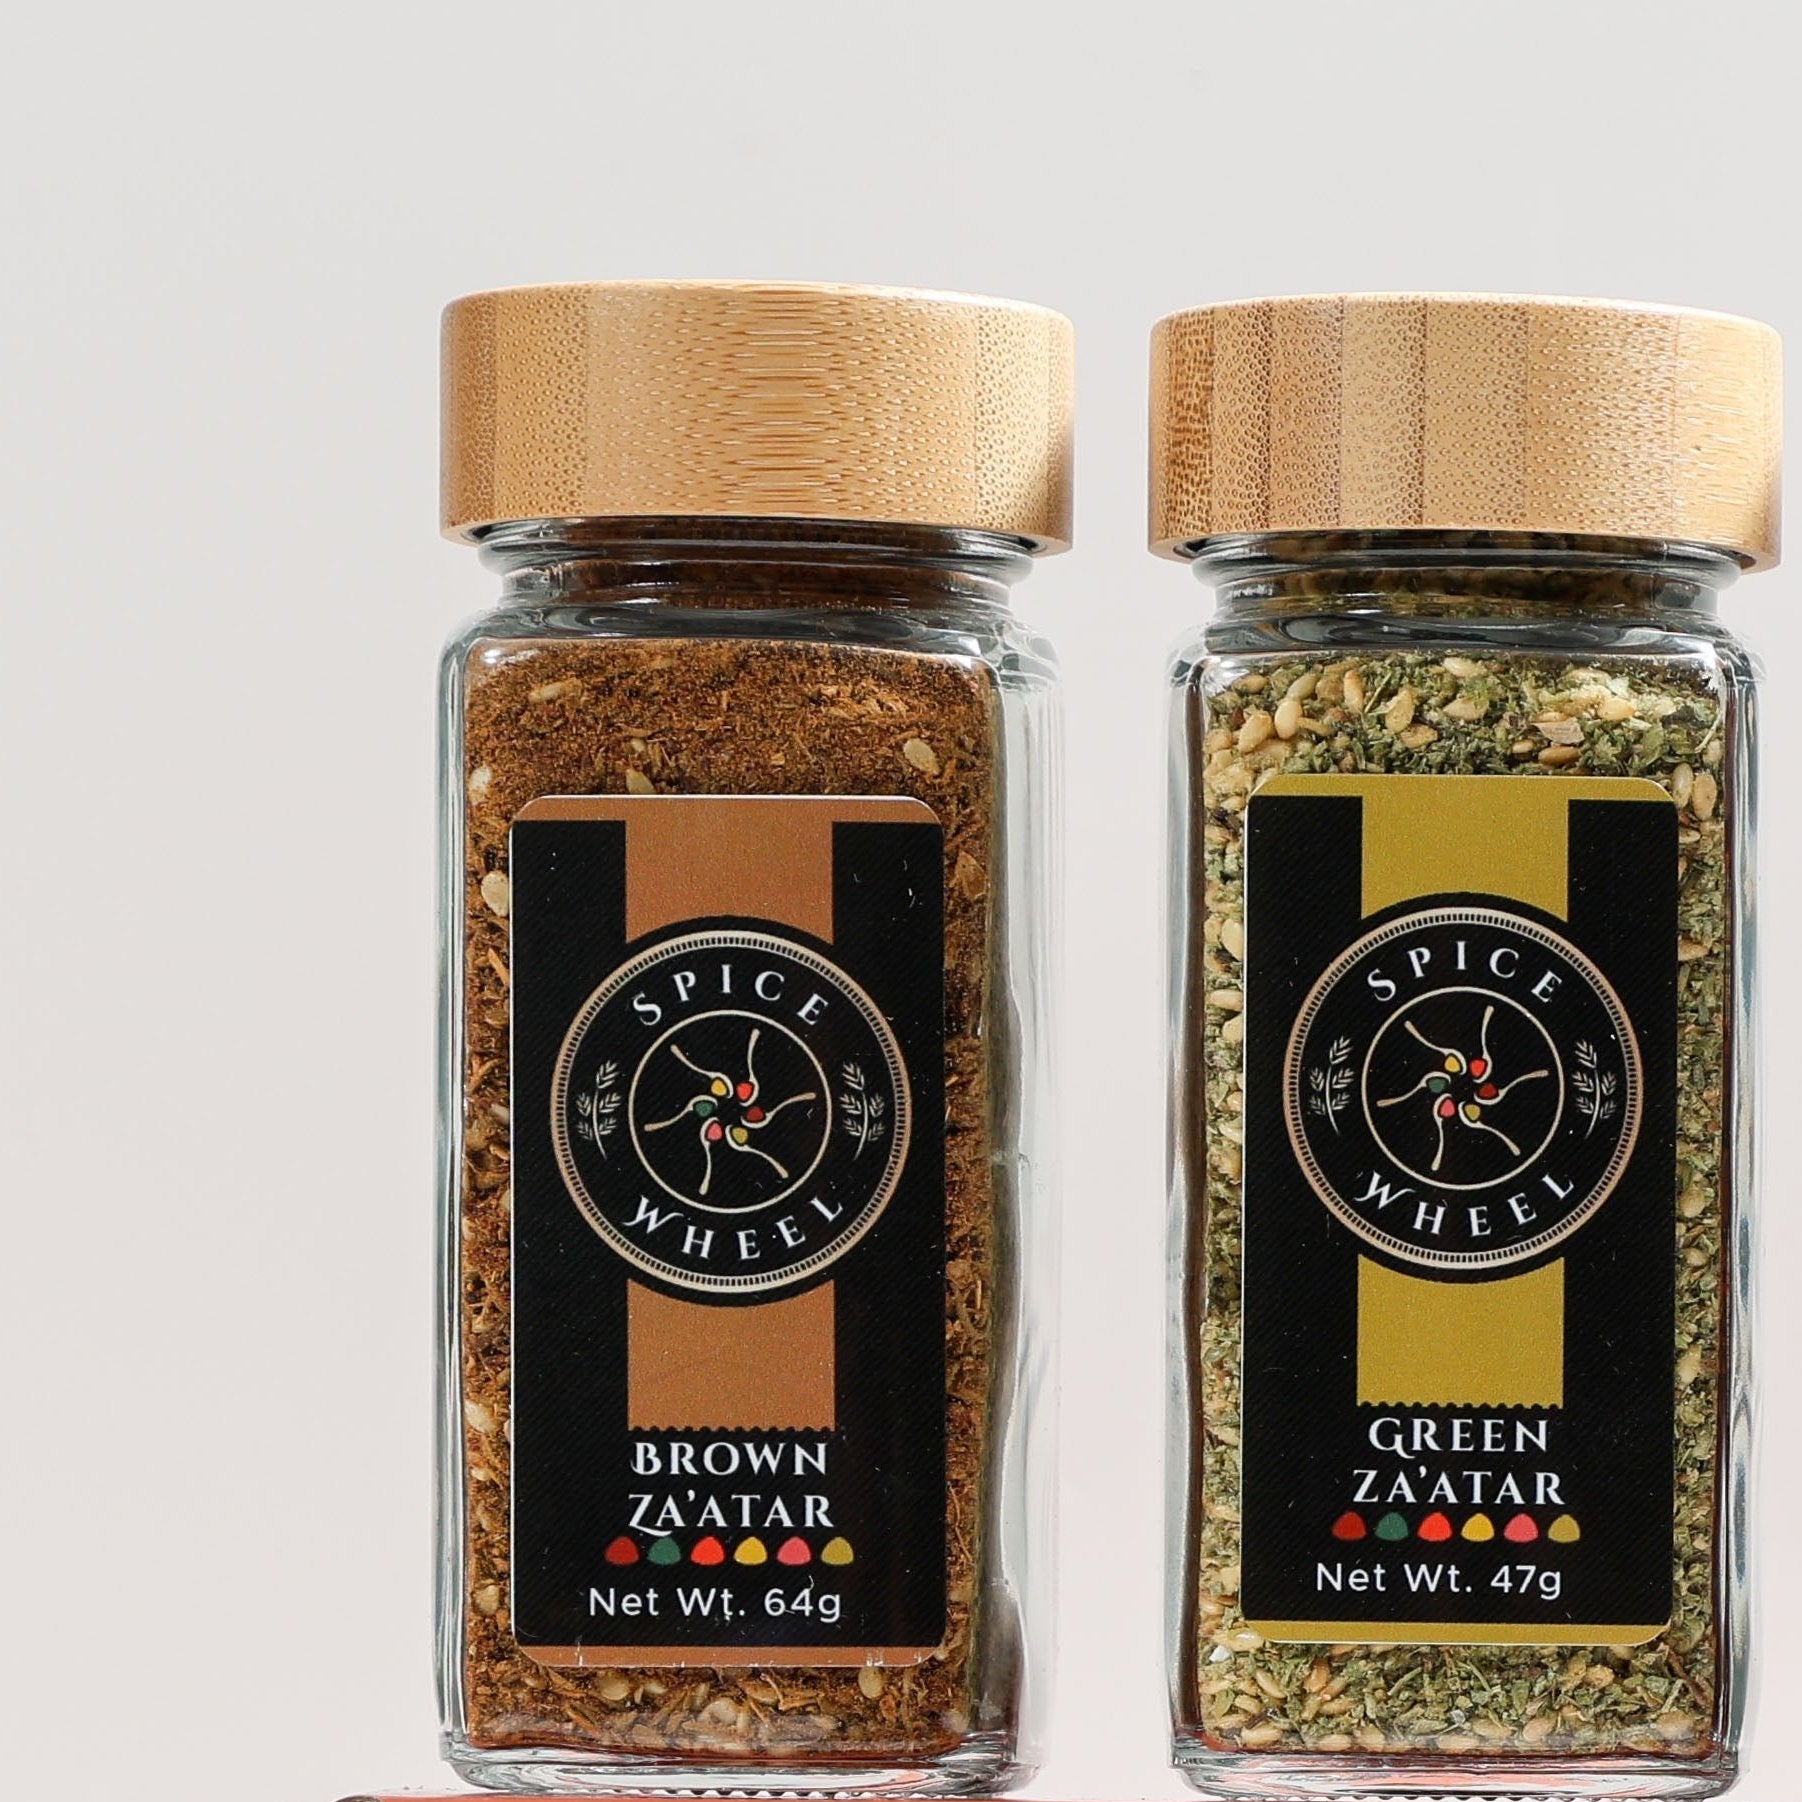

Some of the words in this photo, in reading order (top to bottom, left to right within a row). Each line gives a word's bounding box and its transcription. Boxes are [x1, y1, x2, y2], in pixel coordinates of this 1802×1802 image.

[633, 964, 831, 1028] SPICE
[1367, 940, 1562, 1003] SPICE
[624, 1195, 844, 1262] WHEEL
[1355, 1171, 1574, 1236] WHEEL
[629, 1441, 827, 1476] BROWN
[1369, 1418, 1548, 1459] GREEN
[589, 1586, 660, 1617] Net
[676, 1586, 747, 1617] Wt.
[764, 1587, 843, 1624] 64g
[1317, 1563, 1386, 1593] Net
[1404, 1563, 1473, 1593] Wt.
[1491, 1565, 1562, 1599] 47g
